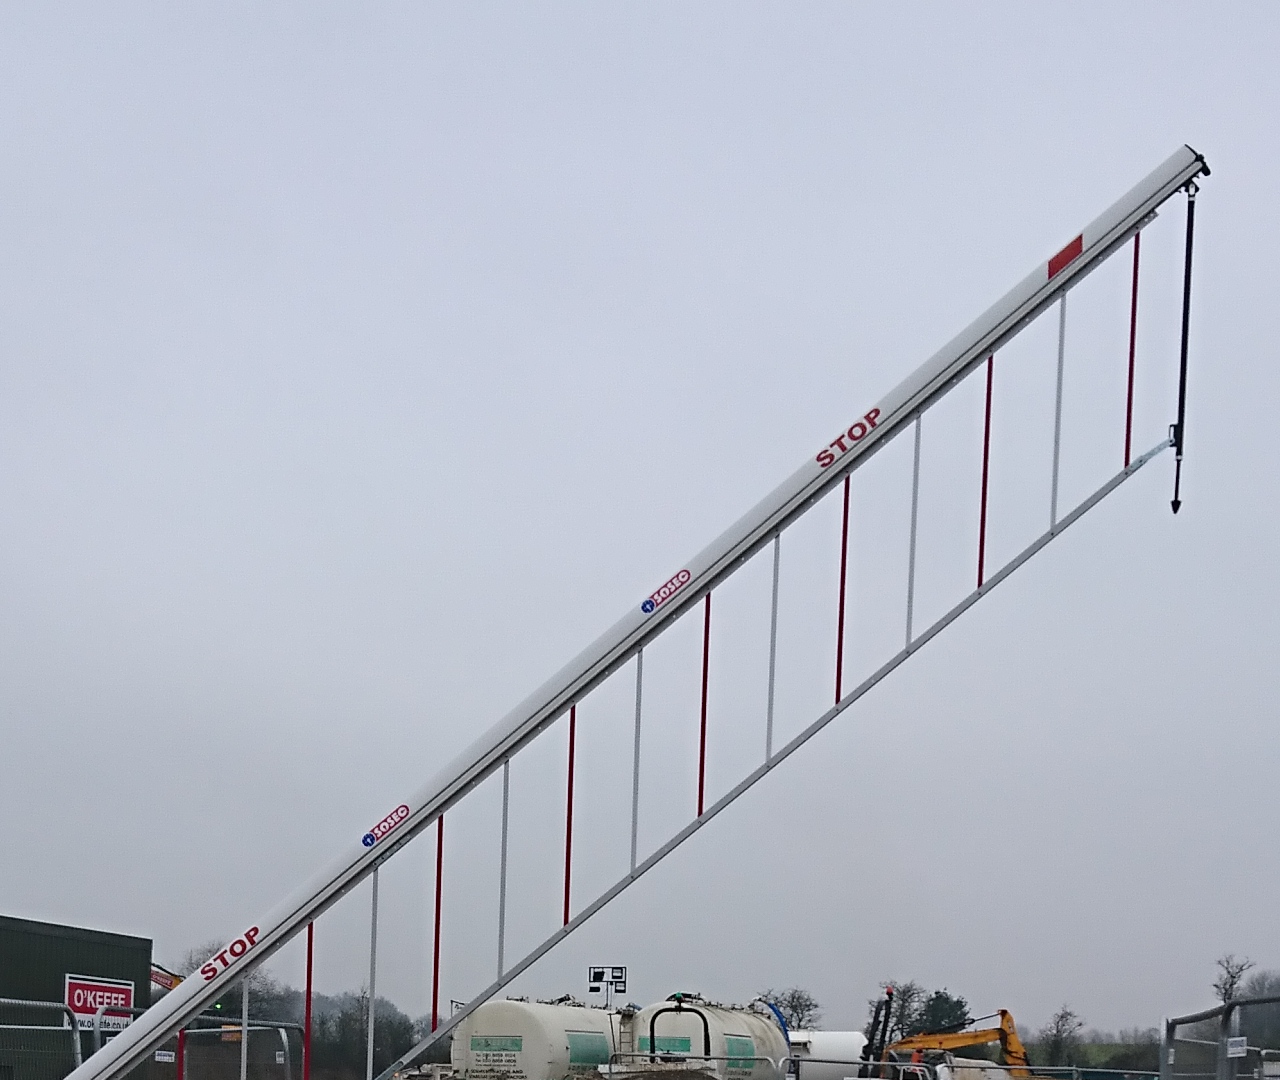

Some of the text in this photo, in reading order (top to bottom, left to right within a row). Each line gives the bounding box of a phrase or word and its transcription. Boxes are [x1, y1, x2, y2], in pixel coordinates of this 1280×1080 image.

[816, 408, 881, 468] STOP
[653, 570, 689, 604] SOSEC
[373, 806, 408, 838] SOSEC
[200, 926, 259, 981] STOP
